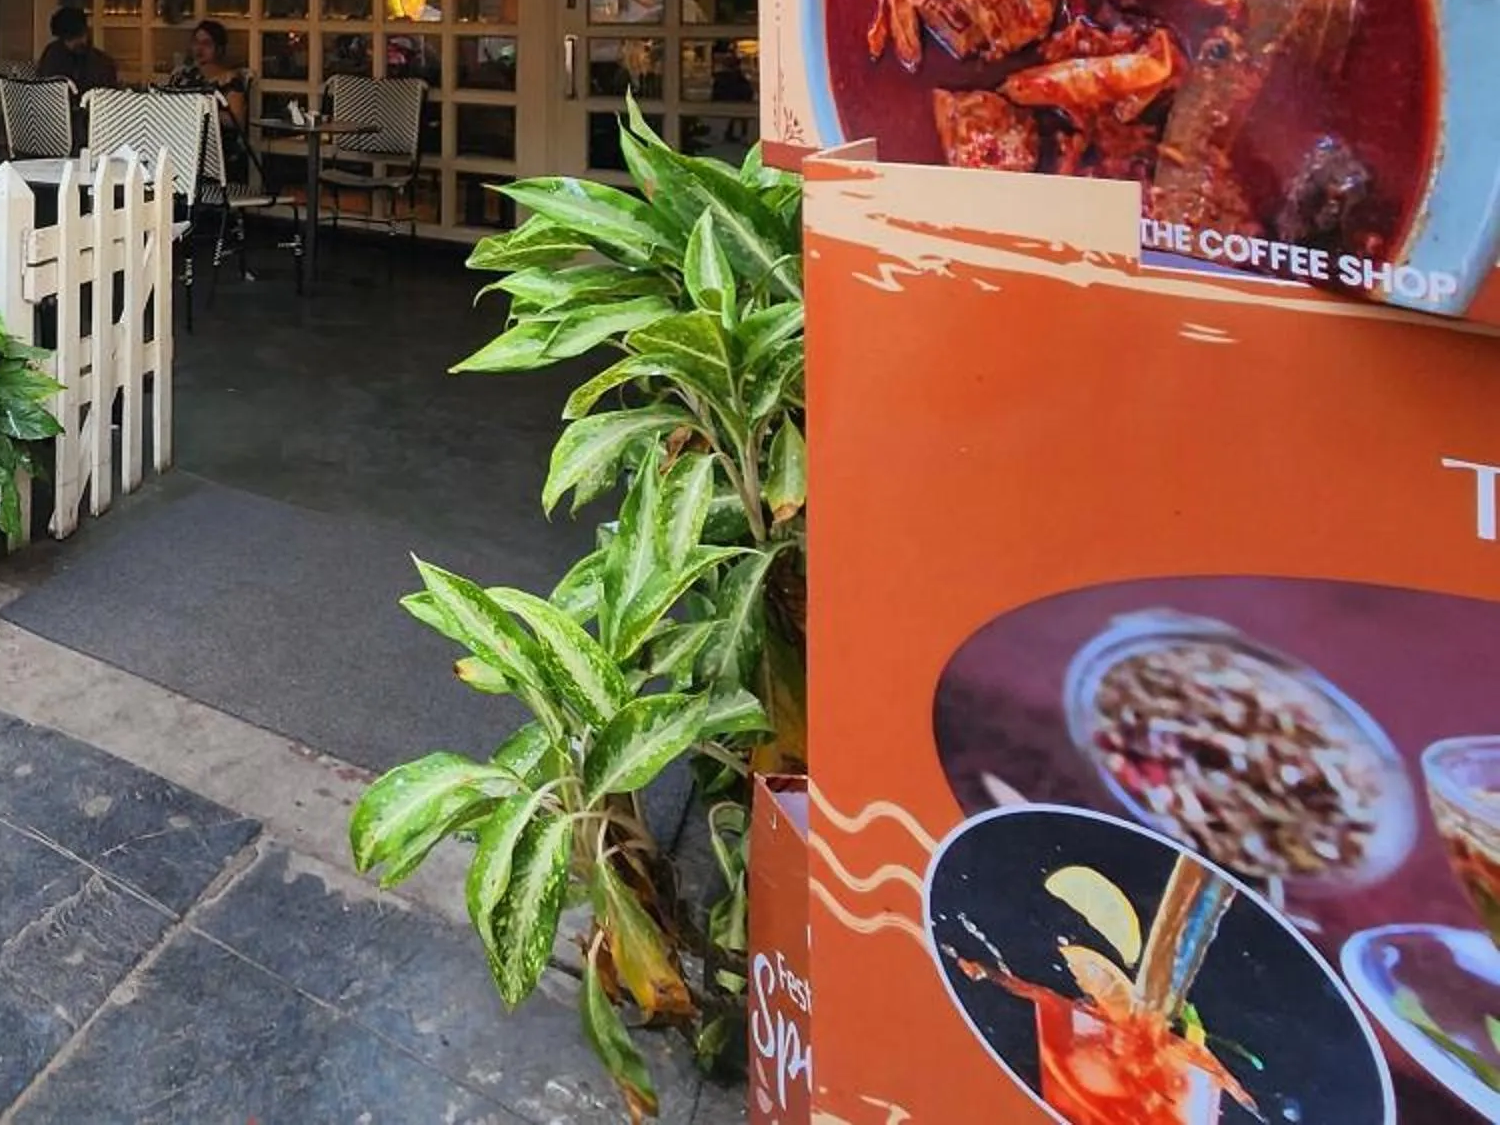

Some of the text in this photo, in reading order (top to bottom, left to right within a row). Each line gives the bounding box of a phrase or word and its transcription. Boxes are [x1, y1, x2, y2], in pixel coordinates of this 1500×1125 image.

[1140, 218, 1458, 302] THE COFFEE SHOP
